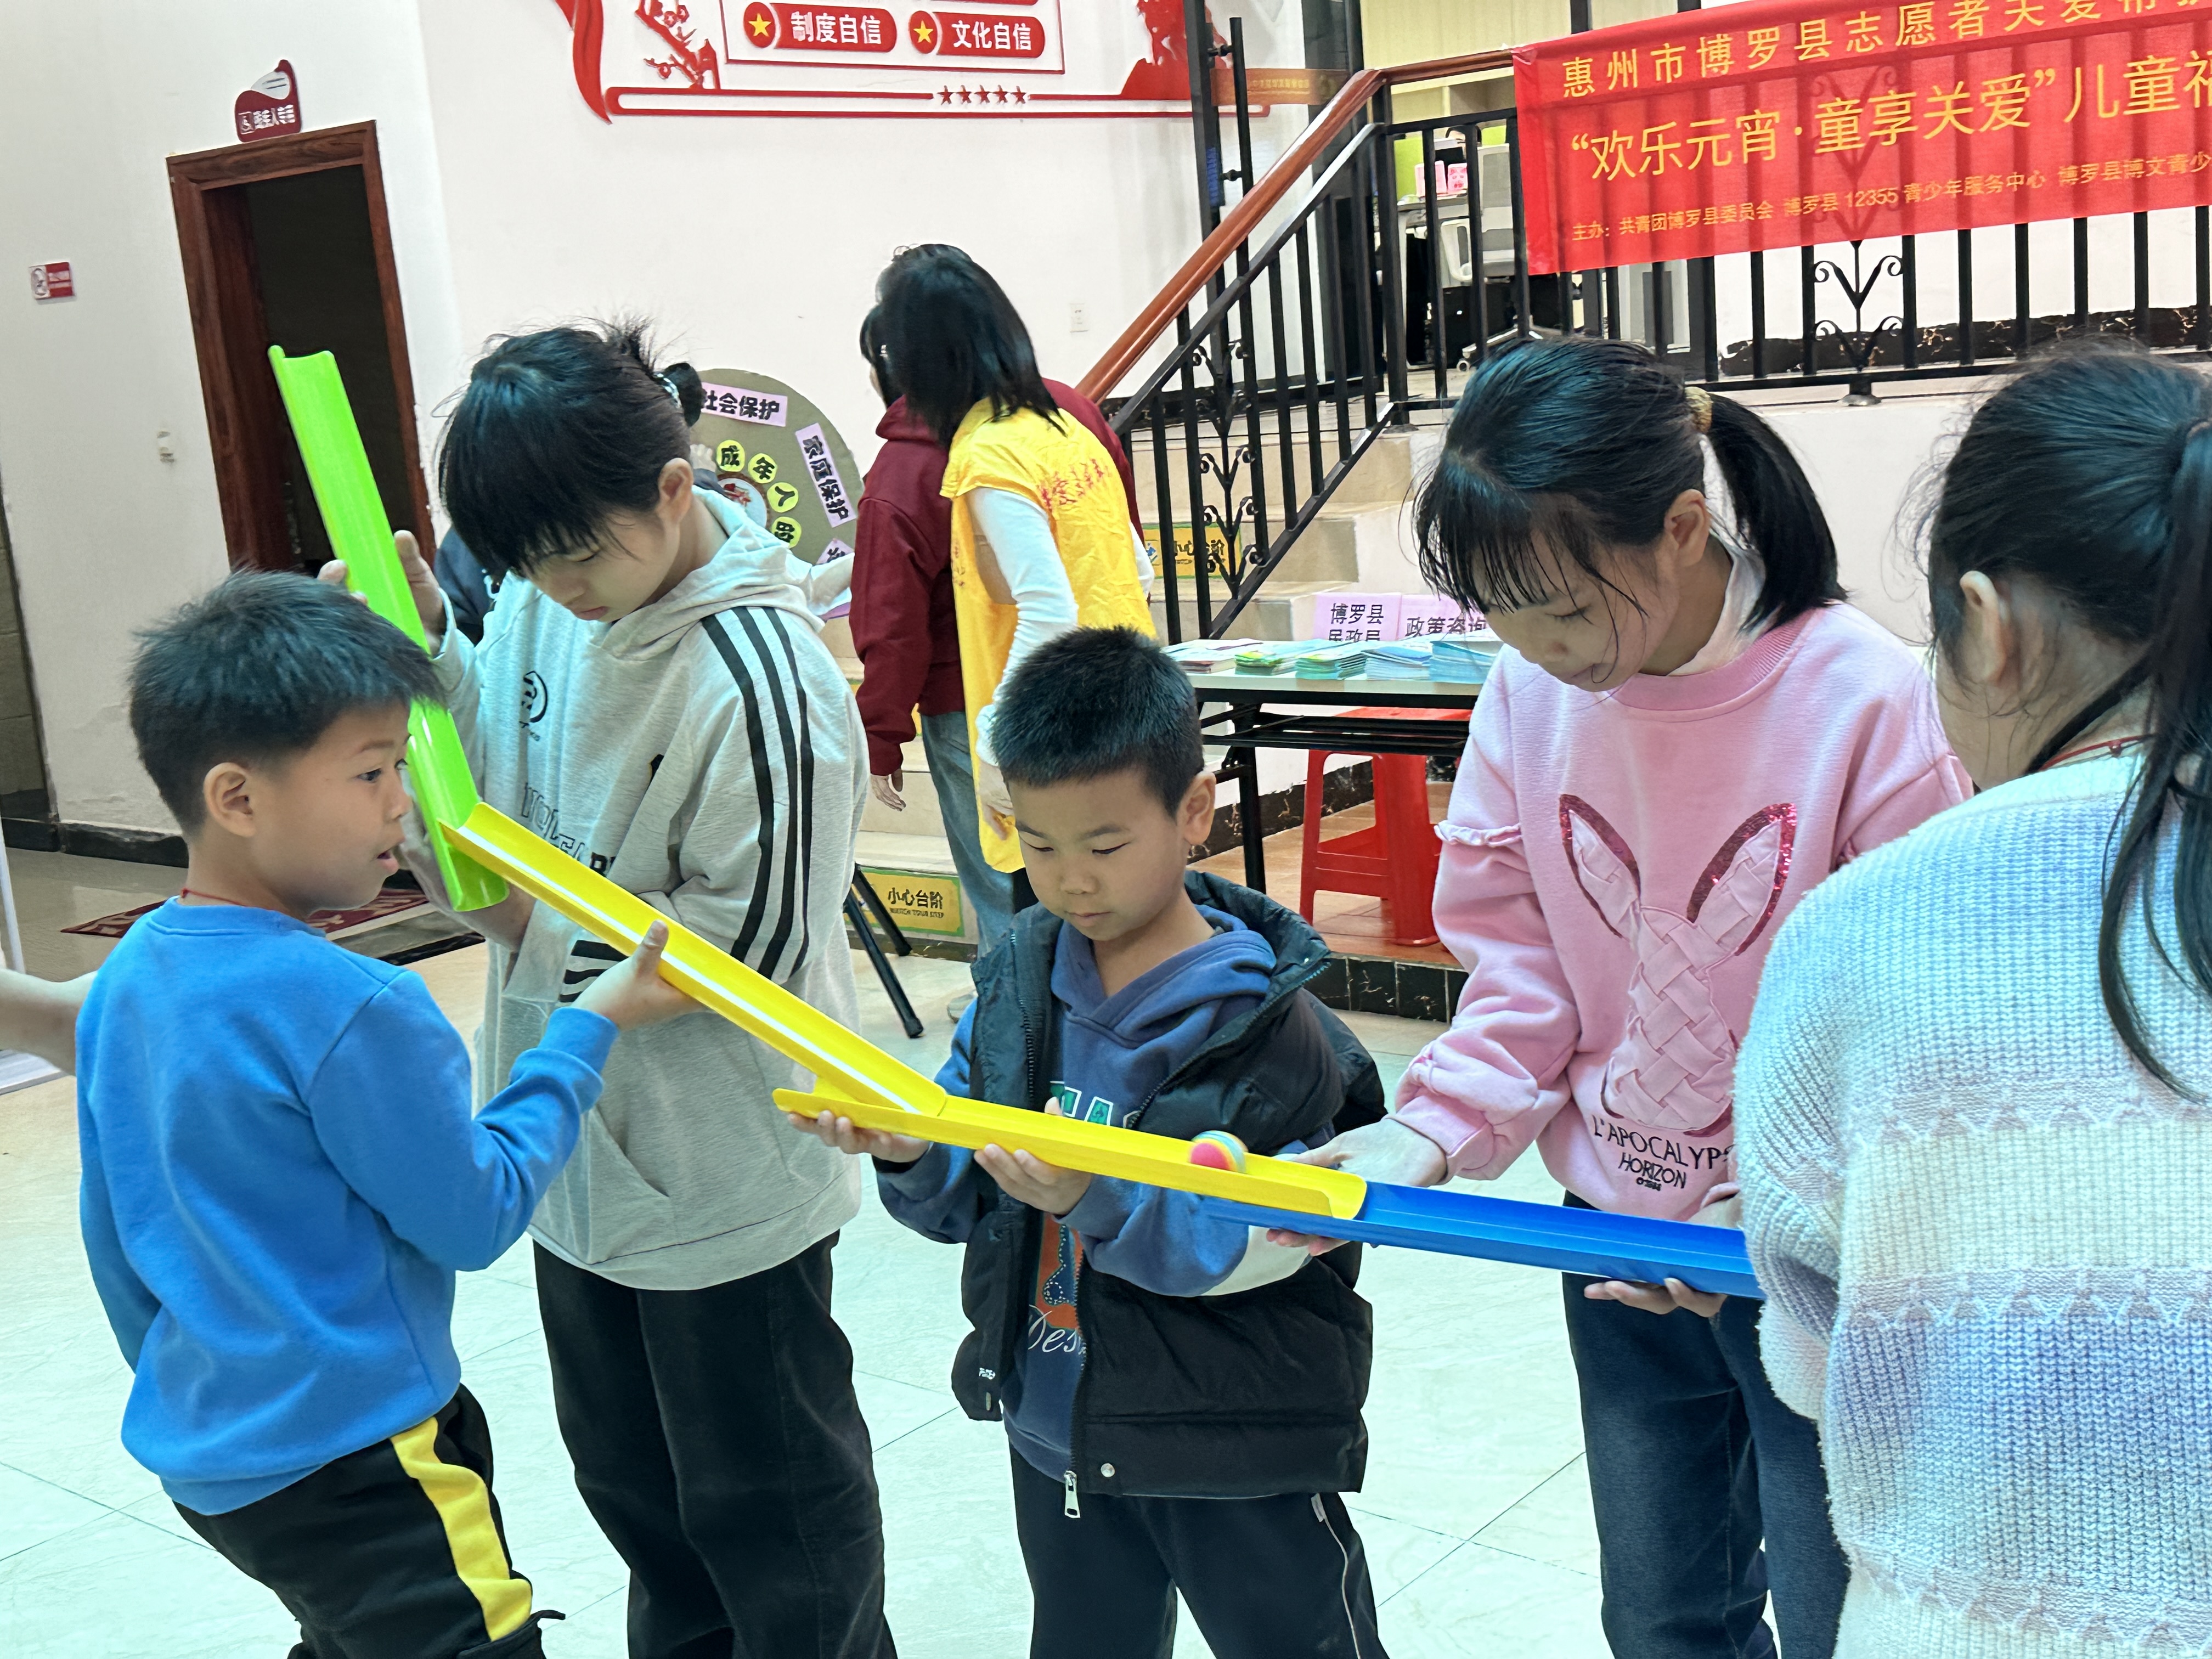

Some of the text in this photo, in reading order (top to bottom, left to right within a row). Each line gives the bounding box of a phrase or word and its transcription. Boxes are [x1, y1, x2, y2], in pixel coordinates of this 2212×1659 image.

[791, 11, 882, 44] 制度自信
[951, 20, 1032, 50] 文化自信
[1562, 0, 2203, 98] 惠州市博罗县志愿者关爱
[1784, 191, 1838, 217] 博罗县
[1846, 189, 1899, 208] 12355
[1903, 171, 2046, 203] 青少年服务中心
[702, 389, 780, 420] 社会保护
[1330, 602, 1384, 625] 博罗县
[1405, 616, 1487, 637] 政策咨询
[888, 887, 943, 910] 小心台阶
[1618, 1152, 1687, 1189] HORIZON
